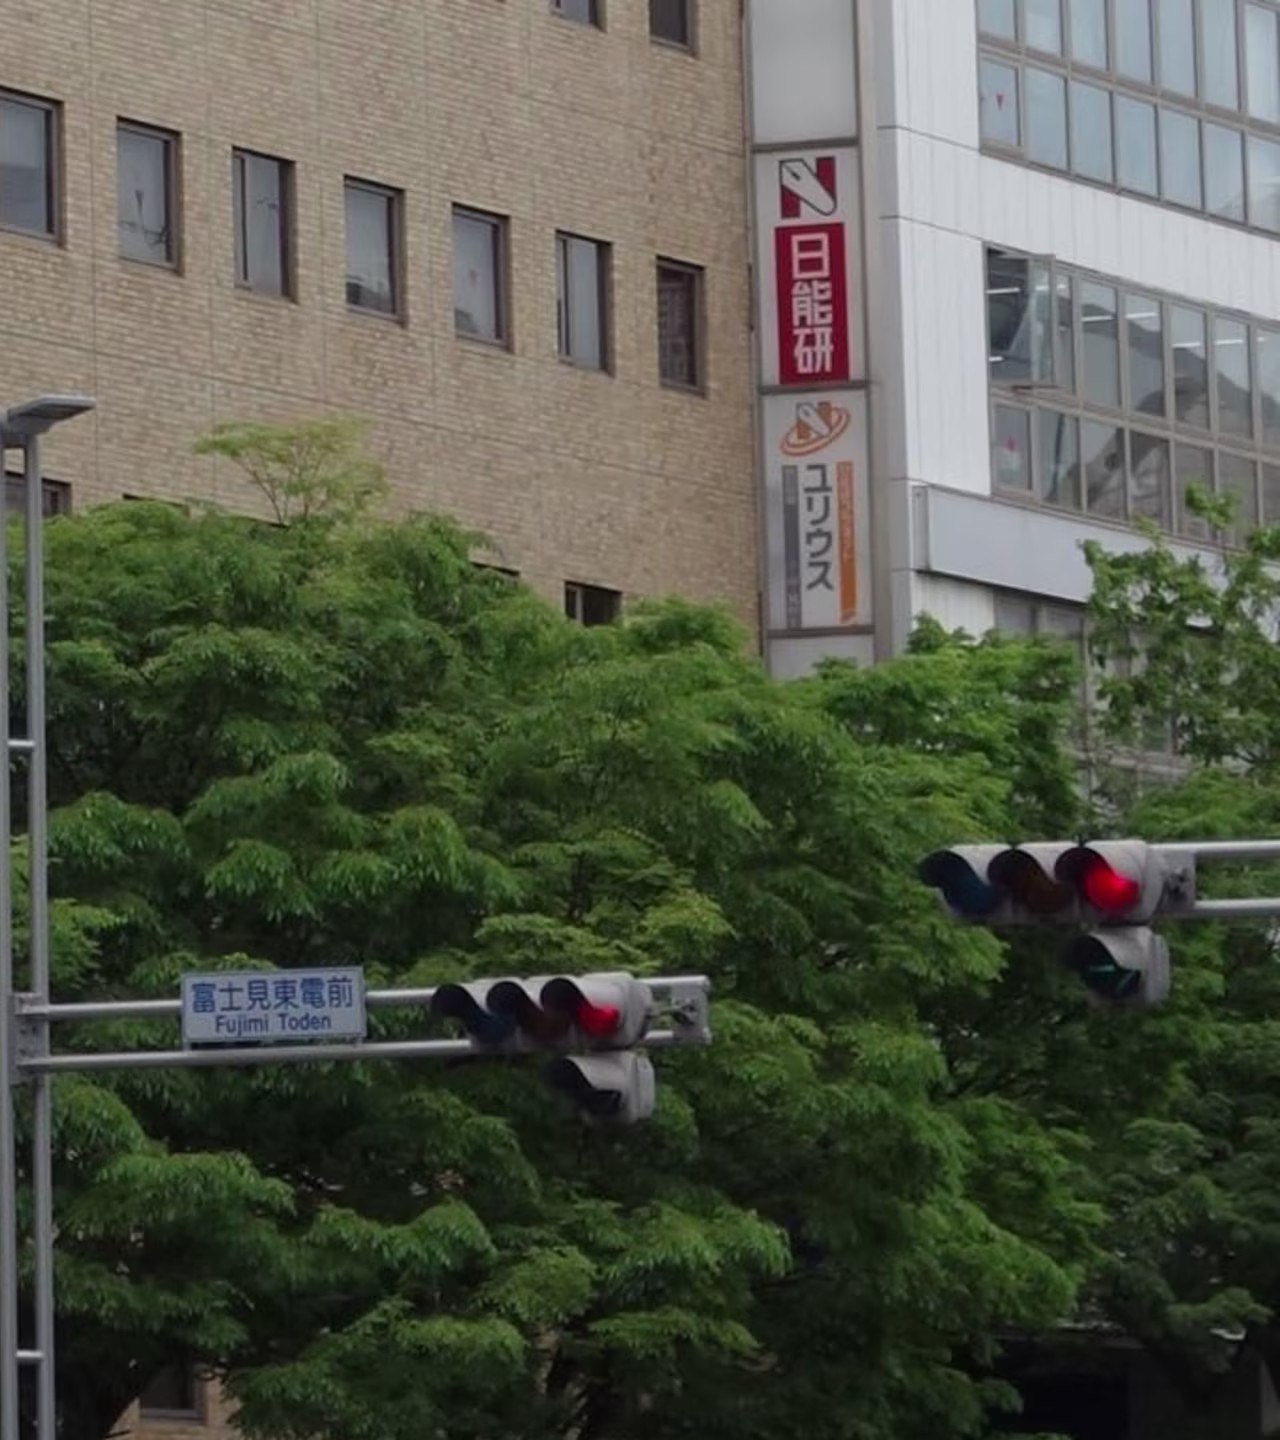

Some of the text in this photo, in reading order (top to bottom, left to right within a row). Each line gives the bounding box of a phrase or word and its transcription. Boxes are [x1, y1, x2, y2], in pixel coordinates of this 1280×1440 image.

[791, 232, 834, 375] 日能研
[803, 464, 835, 591] ユリウス
[191, 976, 353, 1014] 富士見東電前
[215, 1013, 331, 1036] Fujimi Toden
